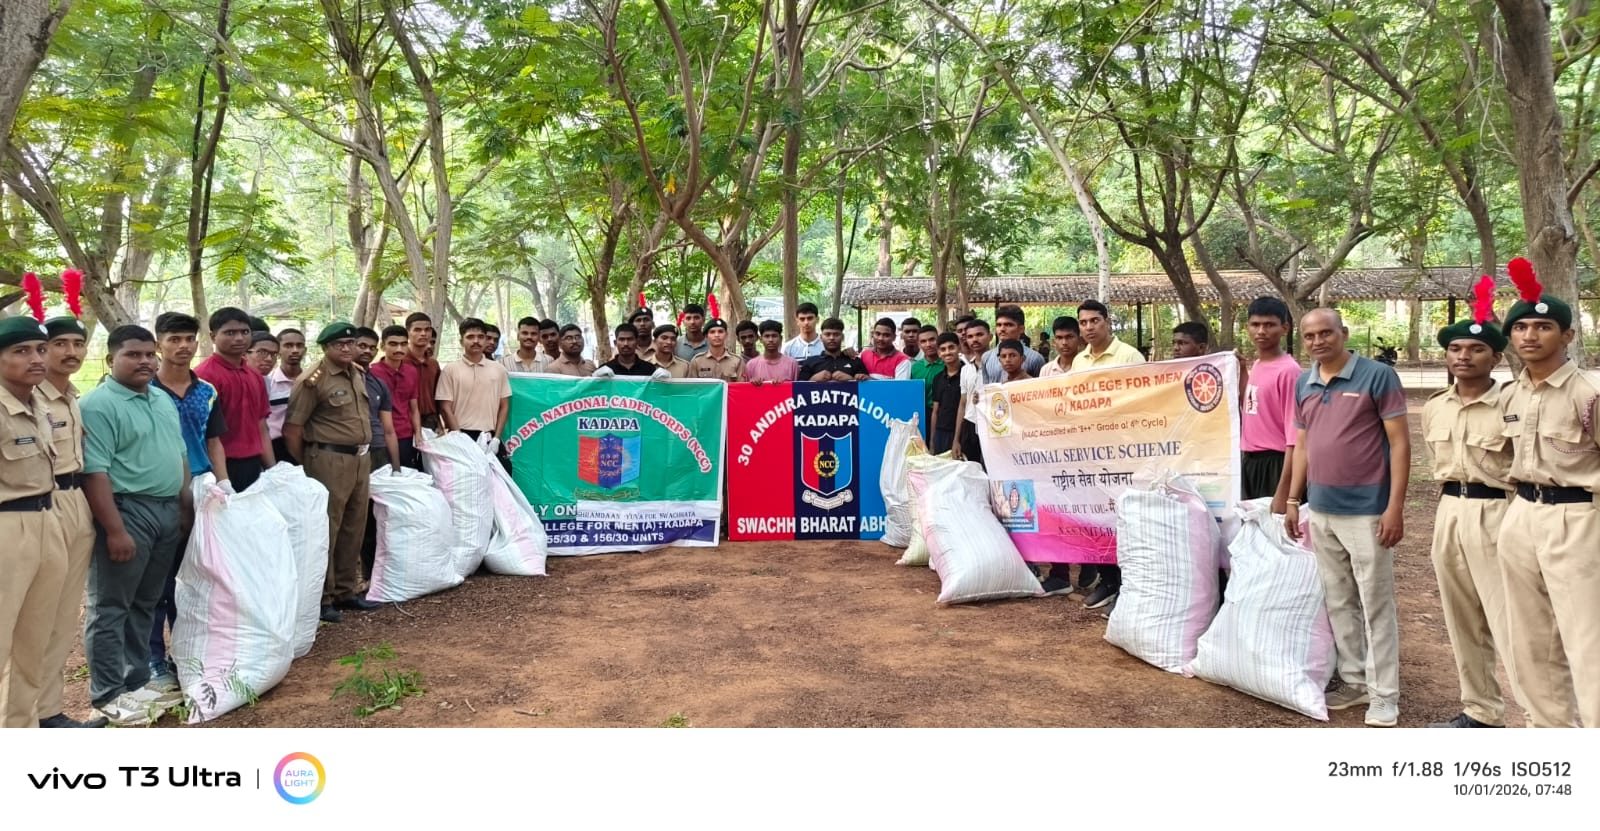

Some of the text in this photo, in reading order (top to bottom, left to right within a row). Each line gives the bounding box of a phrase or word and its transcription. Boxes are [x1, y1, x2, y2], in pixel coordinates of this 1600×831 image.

[1010, 372, 1183, 403] GOVERNMENT COLLEGE FOR MEN
[1054, 397, 1112, 416] (A) KADAPA
[577, 418, 640, 430] KADAPA
[794, 415, 859, 427] KADAPA
[1097, 422, 1119, 431] Grade
[1141, 416, 1167, 429] Cycle)
[517, 418, 544, 440] BN.
[541, 395, 609, 425] NATIONAL
[610, 396, 652, 415] CADET
[652, 408, 691, 441] CORPS
[687, 438, 713, 473] (NCC)
[738, 444, 753, 466] 30
[749, 394, 806, 444] ANDHRA
[1012, 441, 1182, 466] NATIONAL SERVICE SCHEME
[819, 460, 835, 468] NCC
[1052, 468, 1134, 491] राष्ट्रीय सेवा योजना
[531, 504, 549, 517] LY
[1072, 504, 1087, 513] BUT
[545, 522, 584, 531] LLEGE
[587, 521, 611, 530] FOR
[614, 521, 639, 530] MEN
[642, 521, 656, 531] (A)
[664, 519, 704, 529] KADAPA
[737, 516, 888, 533] SWACHH BHARAT ABH
[547, 532, 664, 543] 55/30 & 156/30 UNITS
